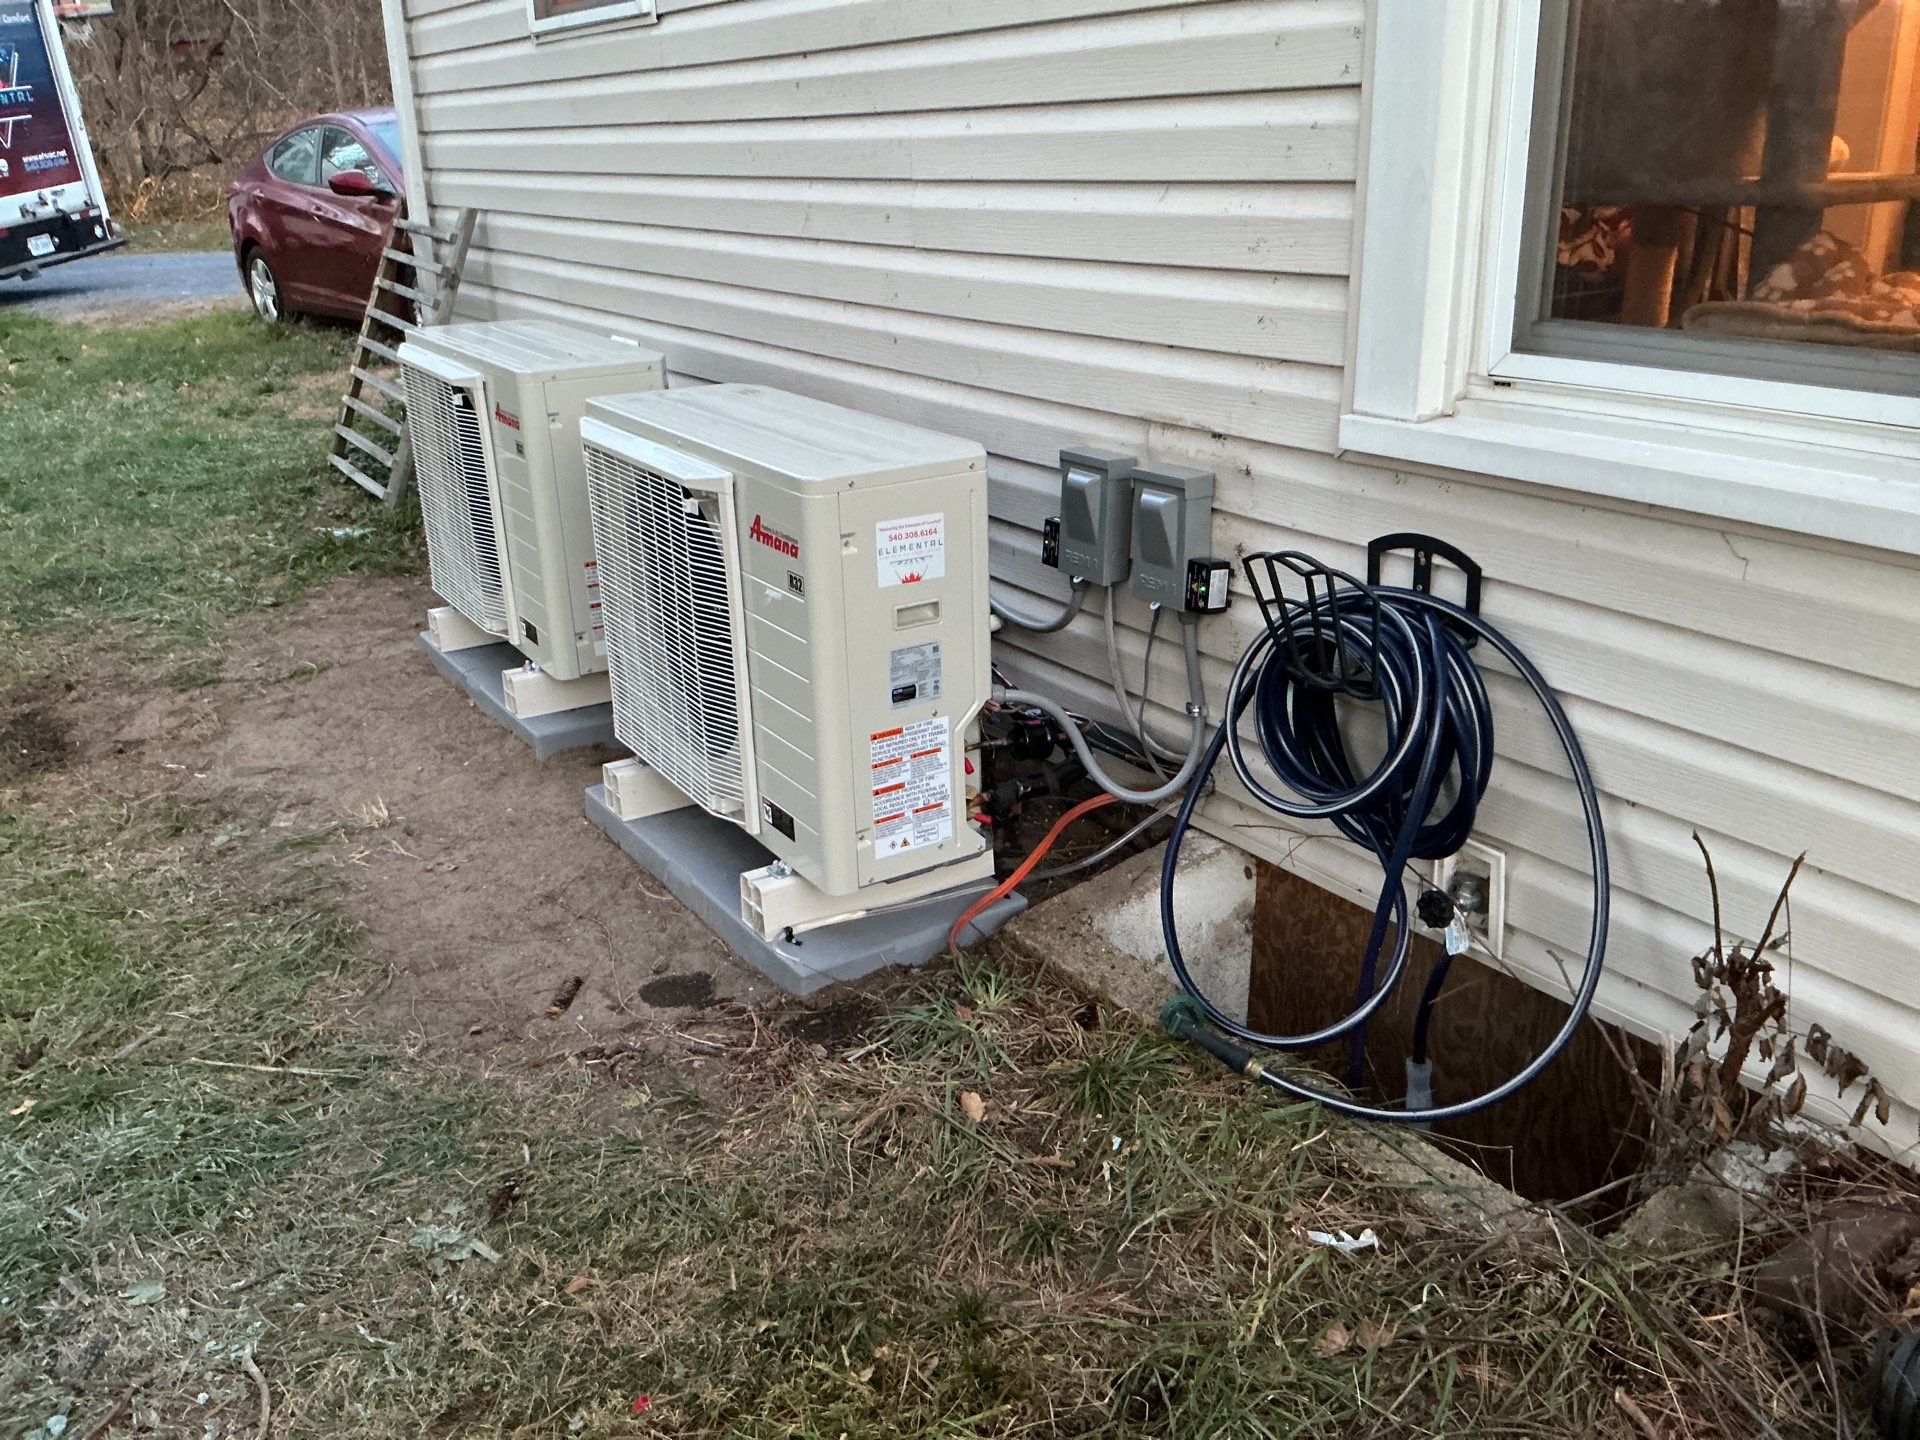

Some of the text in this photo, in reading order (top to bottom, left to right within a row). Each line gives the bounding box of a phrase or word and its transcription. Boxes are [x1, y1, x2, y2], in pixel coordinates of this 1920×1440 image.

[495, 401, 520, 431] Amana
[750, 514, 799, 559] Amana
[889, 528, 938, 542] 540.308.6164
[878, 539, 943, 556] ELEMENTAL
[789, 574, 803, 593] R32
